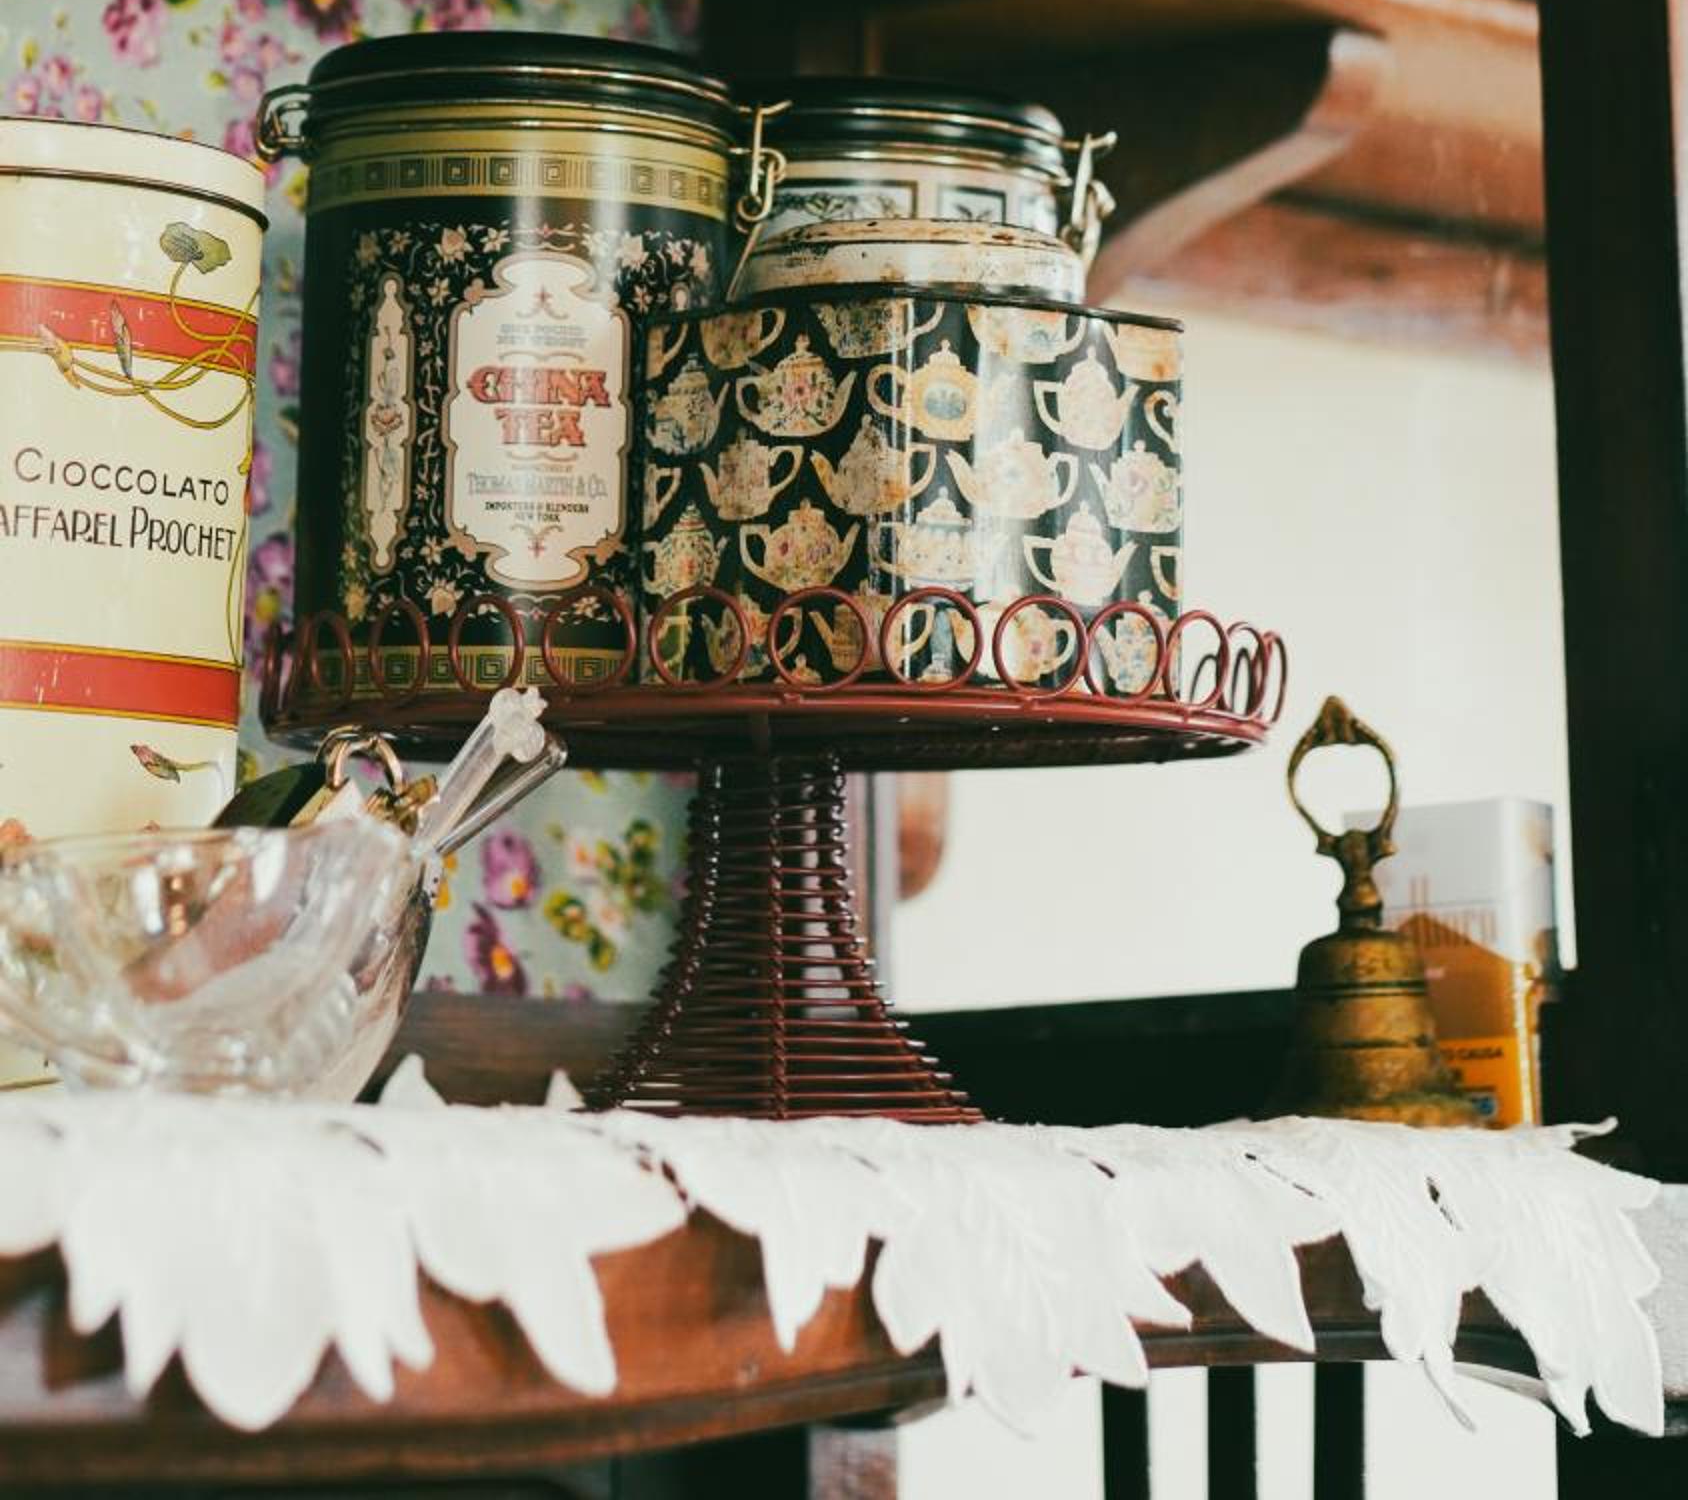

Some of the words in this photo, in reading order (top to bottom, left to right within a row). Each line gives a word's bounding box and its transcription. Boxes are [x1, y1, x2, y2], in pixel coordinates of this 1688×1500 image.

[466, 365, 611, 408] CHINA
[494, 407, 586, 448] TEA
[15, 447, 229, 505] CIOCCOLATO
[130, 505, 236, 562] PROCHET
